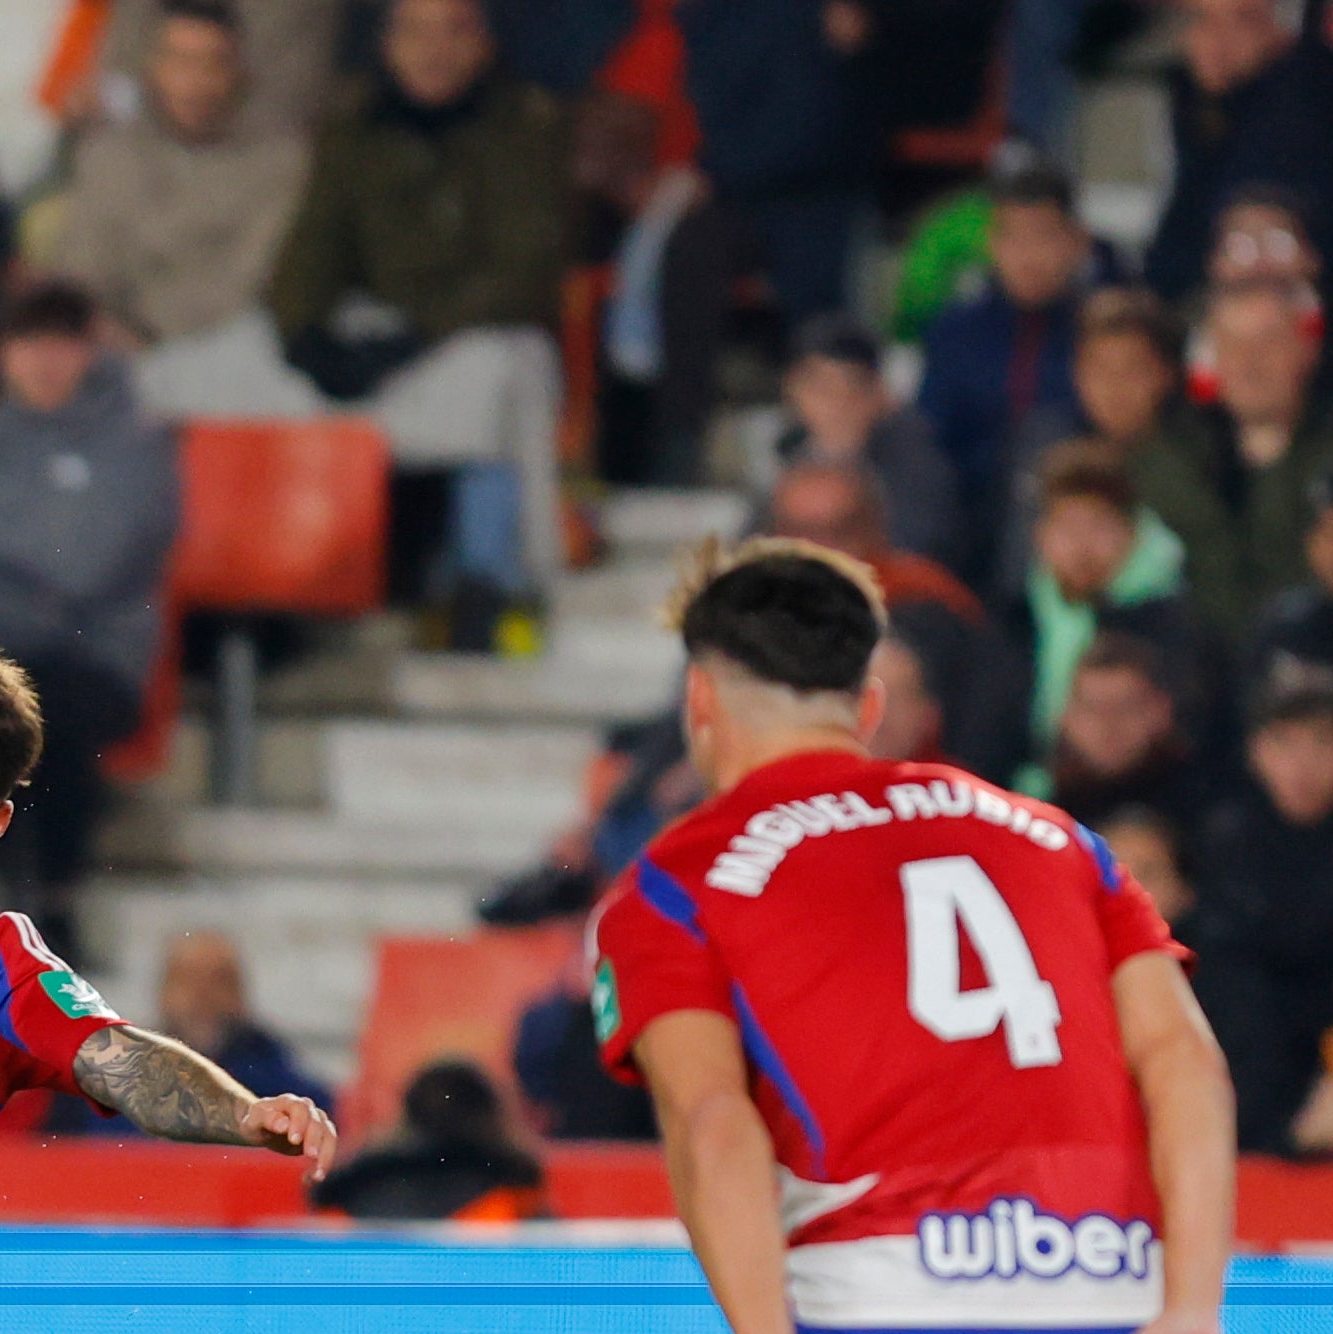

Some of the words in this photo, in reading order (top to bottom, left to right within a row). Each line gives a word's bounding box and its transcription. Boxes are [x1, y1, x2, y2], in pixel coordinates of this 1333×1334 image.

[705, 790, 892, 897] MIGUEL
[885, 779, 1068, 851] RUBIO
[899, 854, 1062, 1070] 4
[917, 1196, 1157, 1281] wiber
